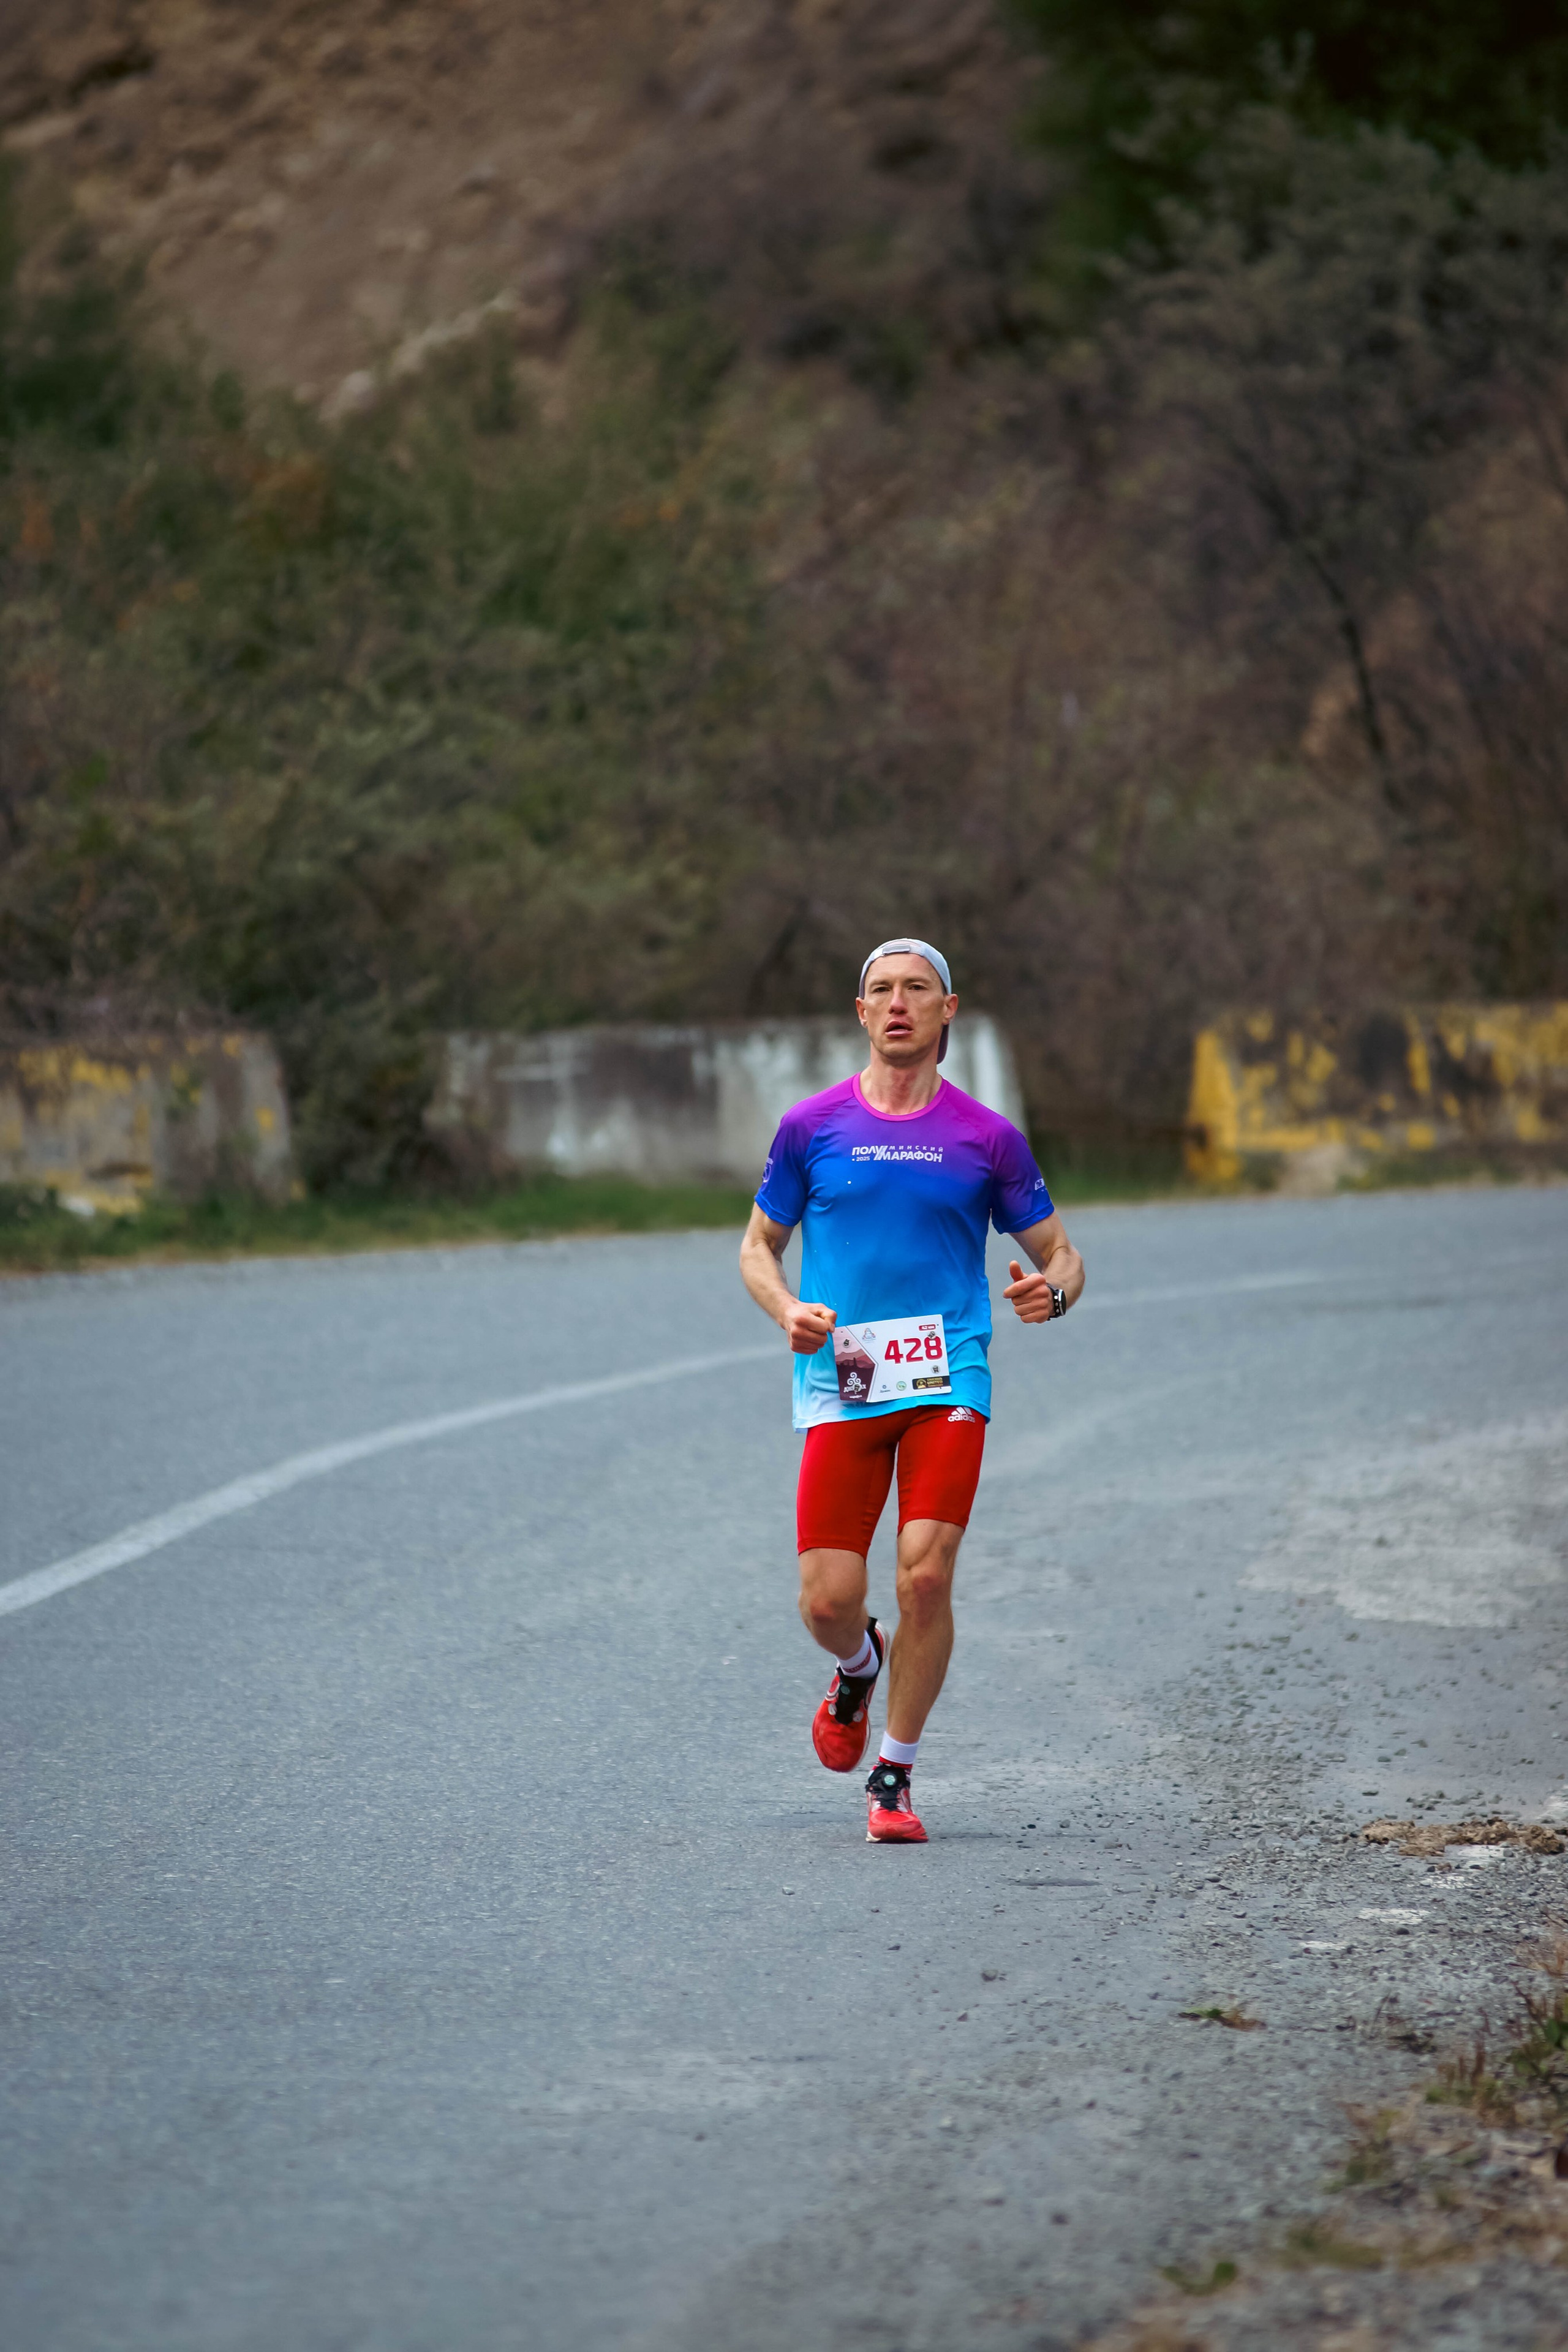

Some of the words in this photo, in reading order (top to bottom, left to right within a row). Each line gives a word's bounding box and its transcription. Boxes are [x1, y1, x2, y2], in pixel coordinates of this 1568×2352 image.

[852, 1145, 886, 1160] ПОЛУ
[876, 1151, 942, 1163] МАРАФОН
[884, 1336, 943, 1364] 428
[948, 1414, 976, 1423] adidas
